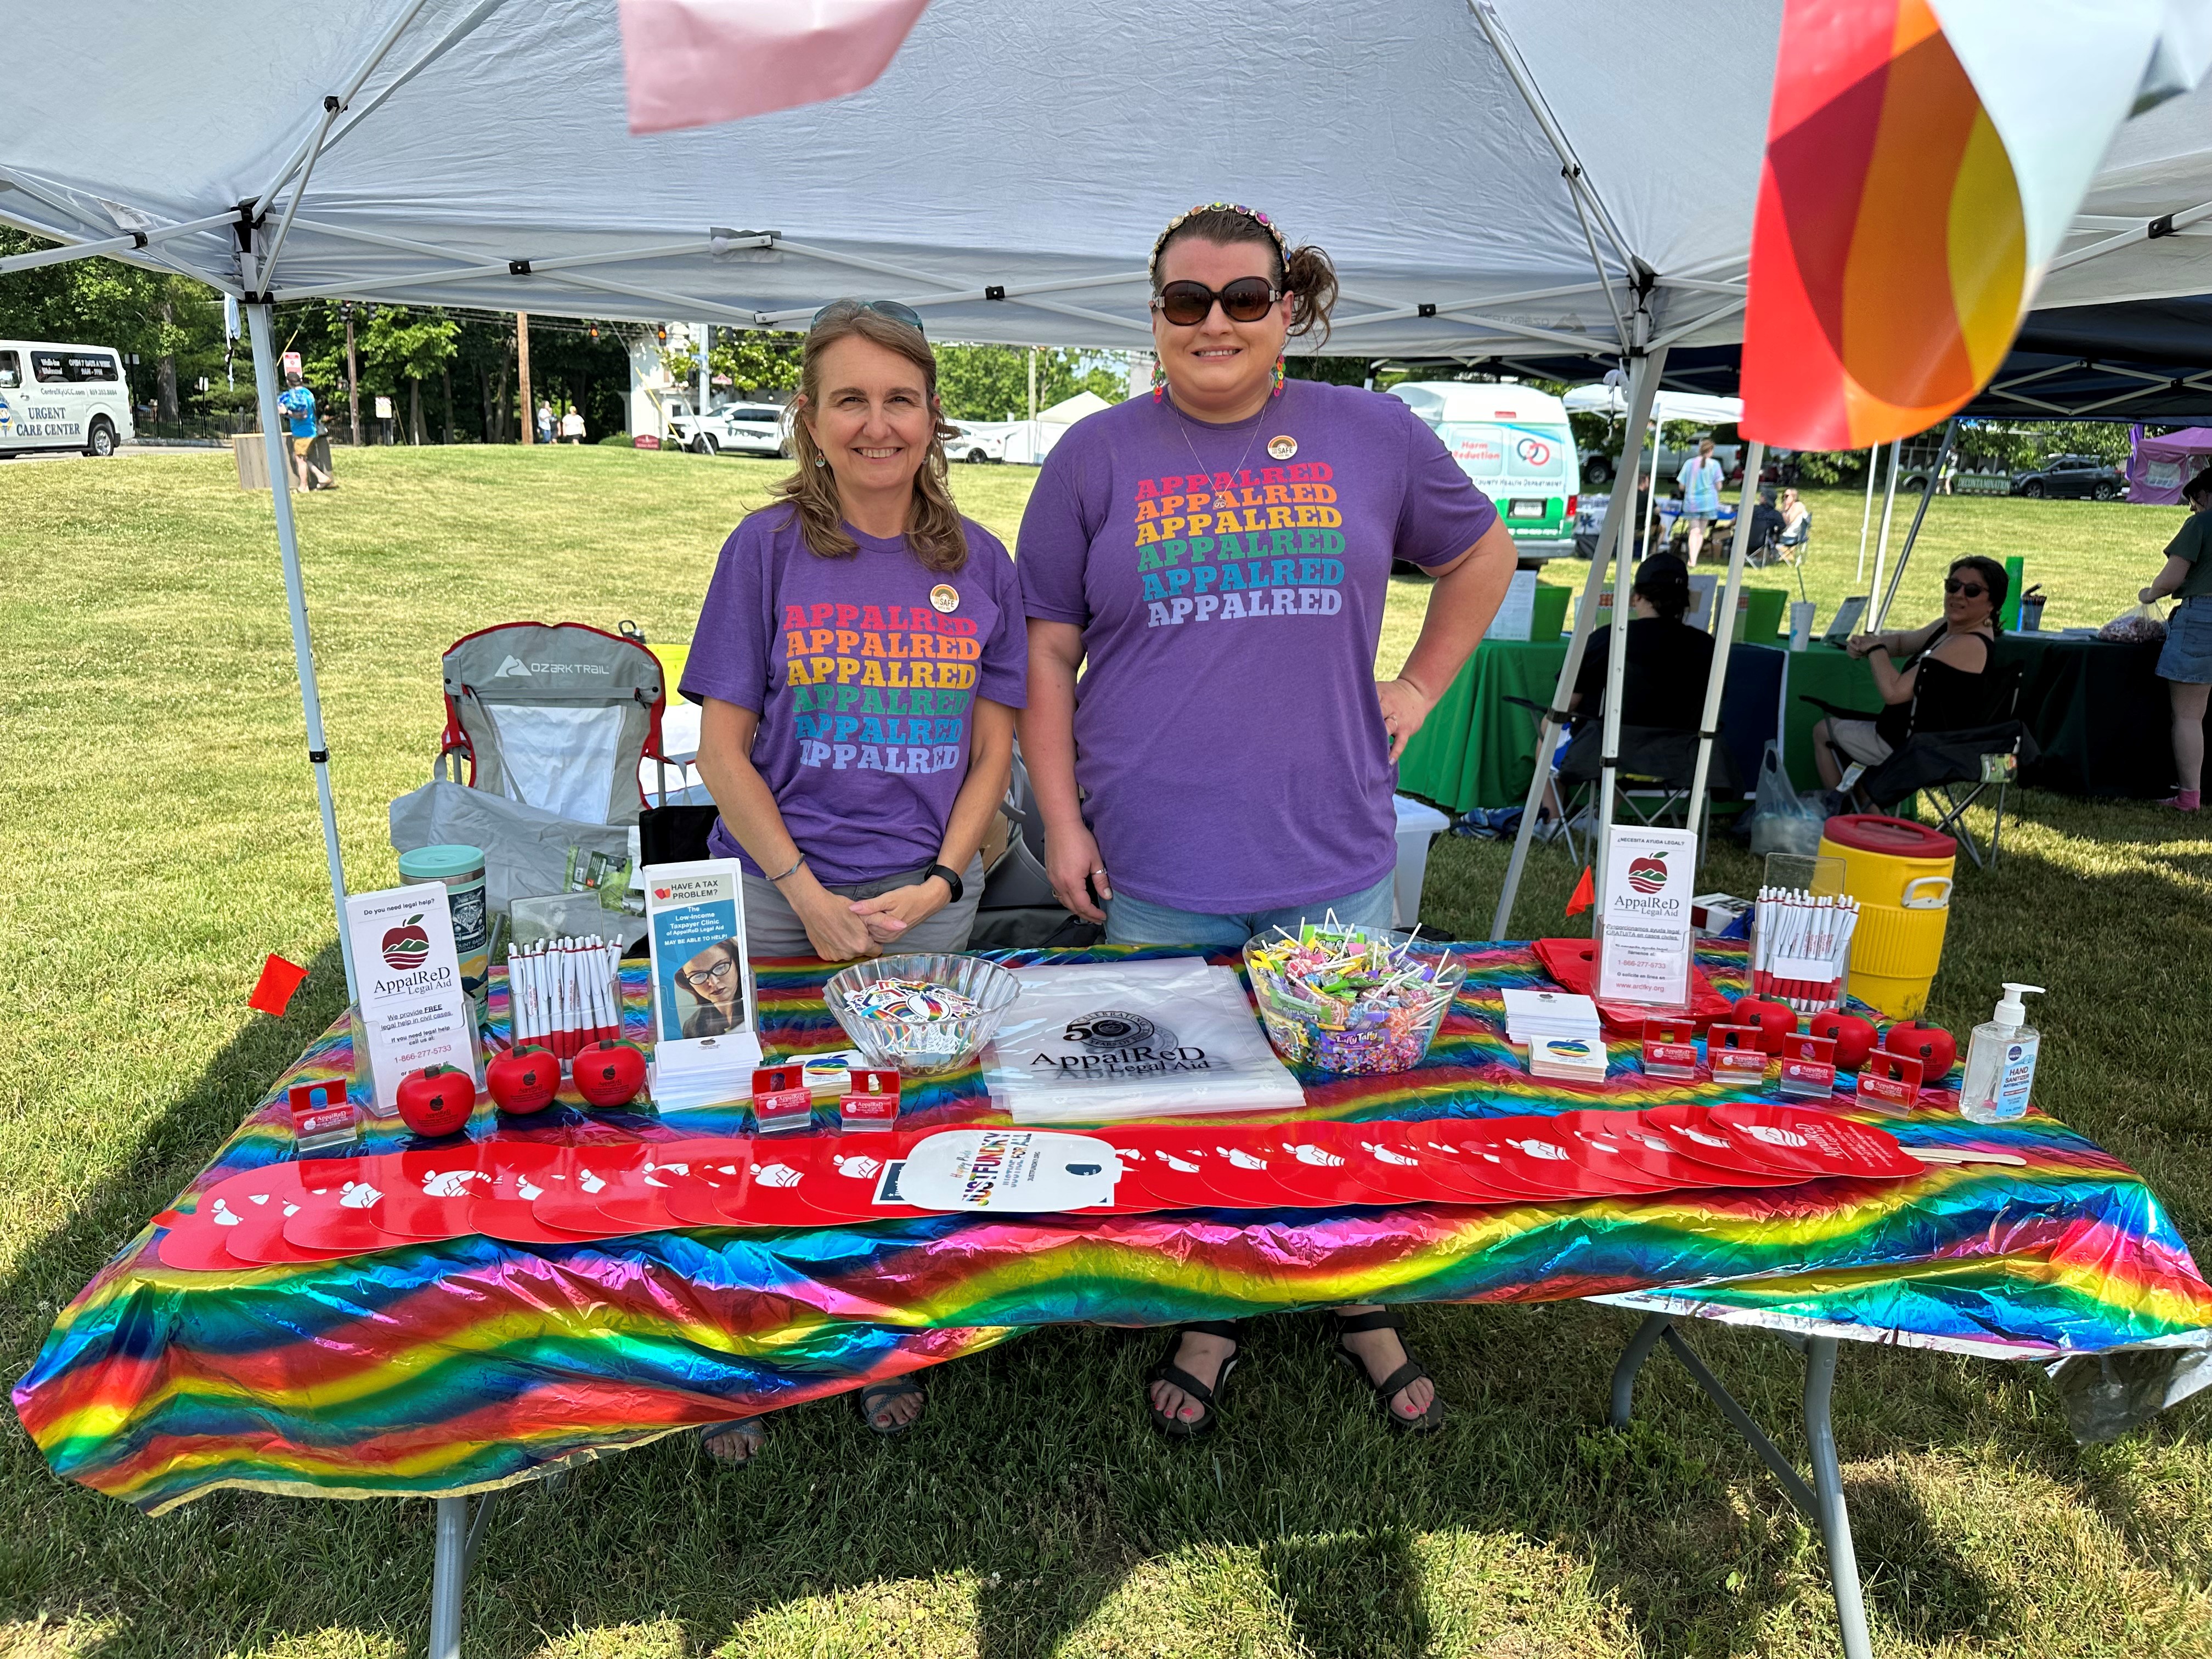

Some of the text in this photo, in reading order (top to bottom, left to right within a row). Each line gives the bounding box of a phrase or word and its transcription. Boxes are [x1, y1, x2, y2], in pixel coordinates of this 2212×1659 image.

[28, 407, 66, 420] URGENT
[16, 423, 81, 436] CARE CENTER
[1462, 441, 1488, 449] Harm
[1453, 450, 1500, 460] Reduction
[1134, 461, 1334, 501] APPALRED
[1957, 477, 2011, 490] DECONTAMINATION
[1134, 483, 1338, 523] APPALRED
[1135, 505, 1343, 547] APPALRED
[1137, 528, 1346, 573] APPALRED
[1142, 558, 1345, 602] APPALRED
[940, 598, 955, 608] SAFE
[1148, 588, 1342, 628] APPALRED
[783, 603, 978, 636] APPALRED
[786, 629, 981, 661] APPALRED
[787, 656, 977, 690] APPALRED
[793, 684, 970, 716] APPALRED
[794, 713, 963, 745] APPALRED
[799, 739, 960, 774] APPALRED
[671, 881, 695, 891] HAVE
[702, 879, 719, 888] TAX
[672, 888, 718, 900] PROBLEM?
[1615, 895, 1679, 910] AppalReD
[374, 907, 386, 915] you
[403, 901, 417, 910] legal
[418, 898, 435, 907] help?
[1641, 907, 1679, 917] Legal Aid
[670, 917, 720, 930] Taxpayer Clinic
[675, 911, 715, 922] Low-Income
[673, 927, 699, 936] AppalReD
[700, 926, 715, 934] Legal
[374, 966, 451, 997] AppalReD
[408, 978, 452, 996] Legal Aid
[399, 1008, 423, 1019] provide
[424, 1004, 443, 1013] FREE
[381, 1022, 397, 1031] legal
[397, 1019, 411, 1028] help
[420, 1014, 432, 1022] civil
[433, 1011, 453, 1020] cases.
[1077, 1011, 1149, 1031] CELEBRATING
[1090, 1038, 1116, 1047] YEARS
[1357, 1030, 1378, 1041] Taffy
[394, 1044, 452, 1064] 1-866-277-5733
[1030, 1046, 1206, 1069] AppalReD
[1109, 1059, 1211, 1075] Legal Aid
[1802, 1065, 1828, 1074] AppalReD
[2009, 1066, 2029, 1076] HAND
[2003, 1079, 2029, 1088] ANTIBACTERIAL
[2005, 1073, 2030, 1084] SANITIZER
[317, 1110, 346, 1122] AppalReD
[1796, 1123, 1844, 1160] AppalReD
[1810, 1124, 1841, 1146] Legal Aid
[962, 1132, 1011, 1206] JUSTFUNDKY
[1002, 1133, 1032, 1188] JUSTICE FOR ALL
[950, 1161, 972, 1178] Happy
